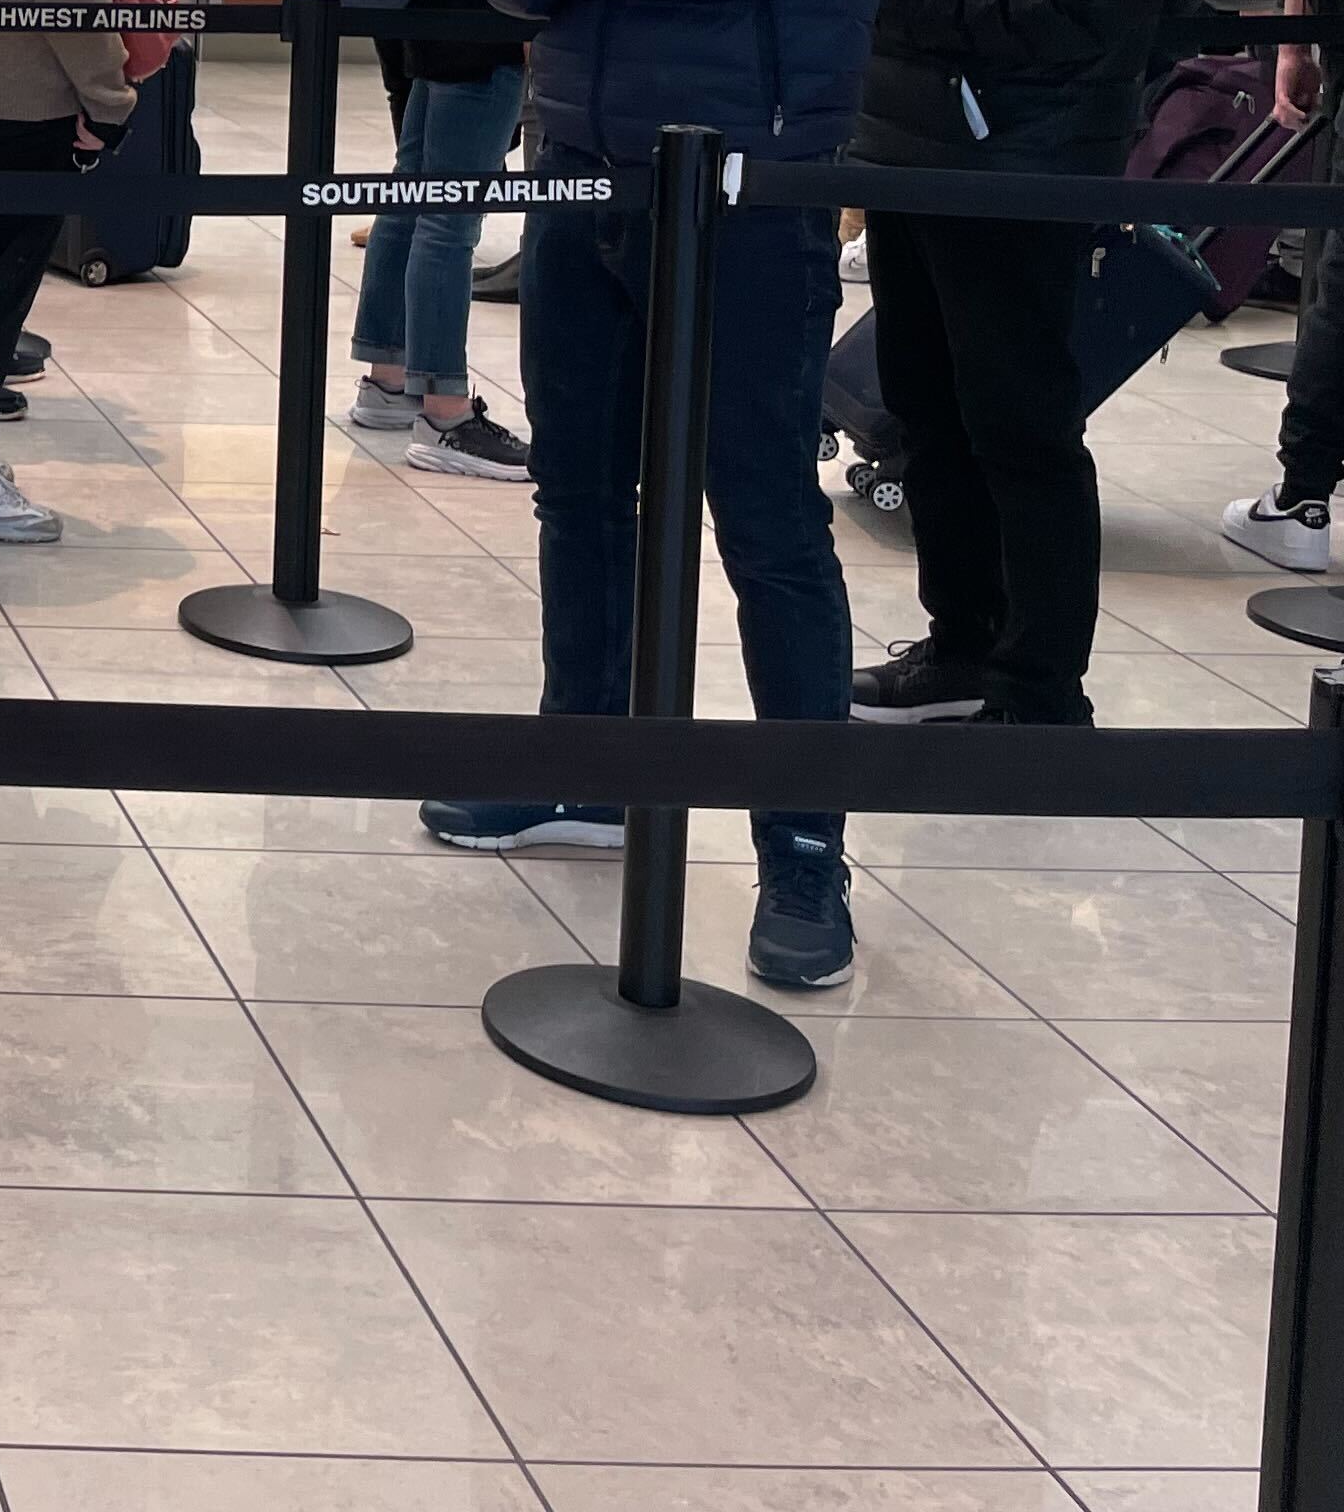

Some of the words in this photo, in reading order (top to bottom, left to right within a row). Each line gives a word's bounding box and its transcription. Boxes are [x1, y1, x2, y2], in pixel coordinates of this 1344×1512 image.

[92, 8, 206, 30] AIRLINES
[301, 180, 480, 206] SOUTHWEST
[483, 178, 612, 203] AIRLINES
